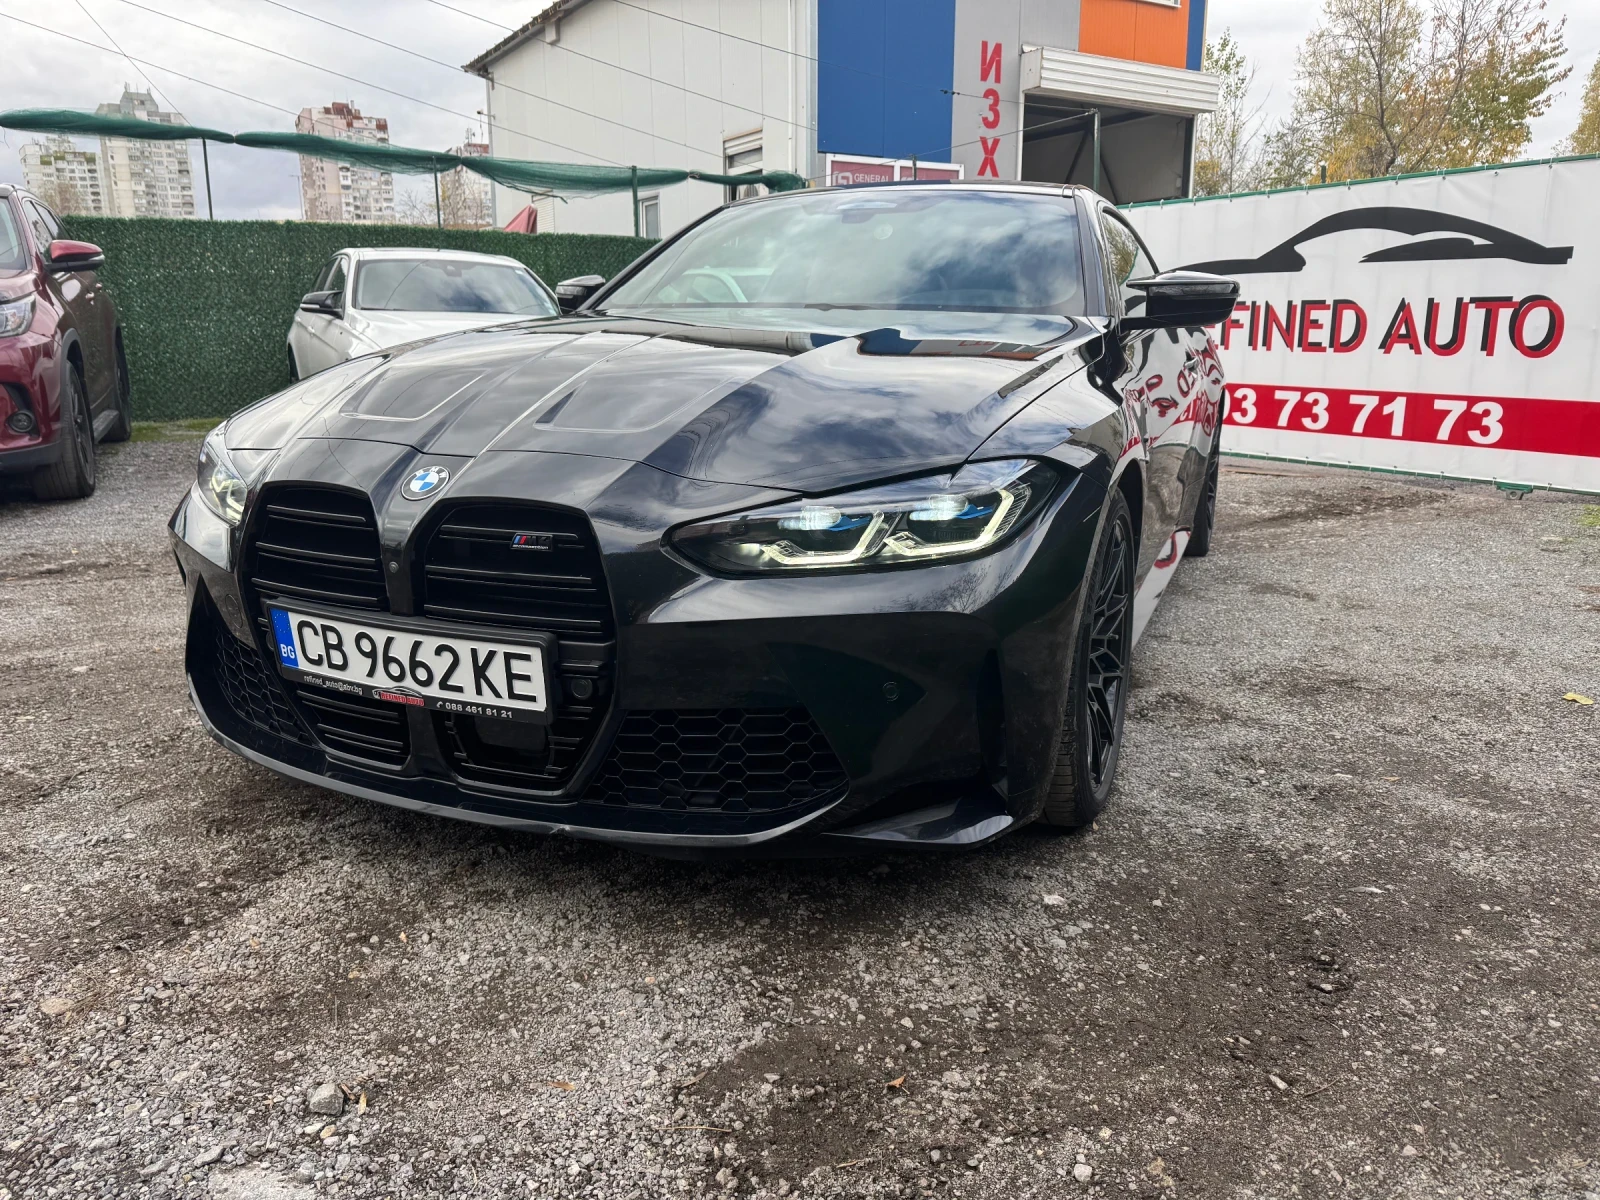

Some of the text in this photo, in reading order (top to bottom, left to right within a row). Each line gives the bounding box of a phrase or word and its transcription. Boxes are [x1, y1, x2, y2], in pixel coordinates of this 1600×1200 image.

[1204, 294, 1565, 359] FINED AUTO
[1223, 386, 1258, 424] 3
[1273, 389, 1330, 431] 73
[1349, 394, 1407, 437] 71
[1433, 399, 1504, 445] 73
[280, 644, 295, 659] BG
[381, 691, 407, 704] REFINED
[445, 702, 513, 719] 088 461 81 21
